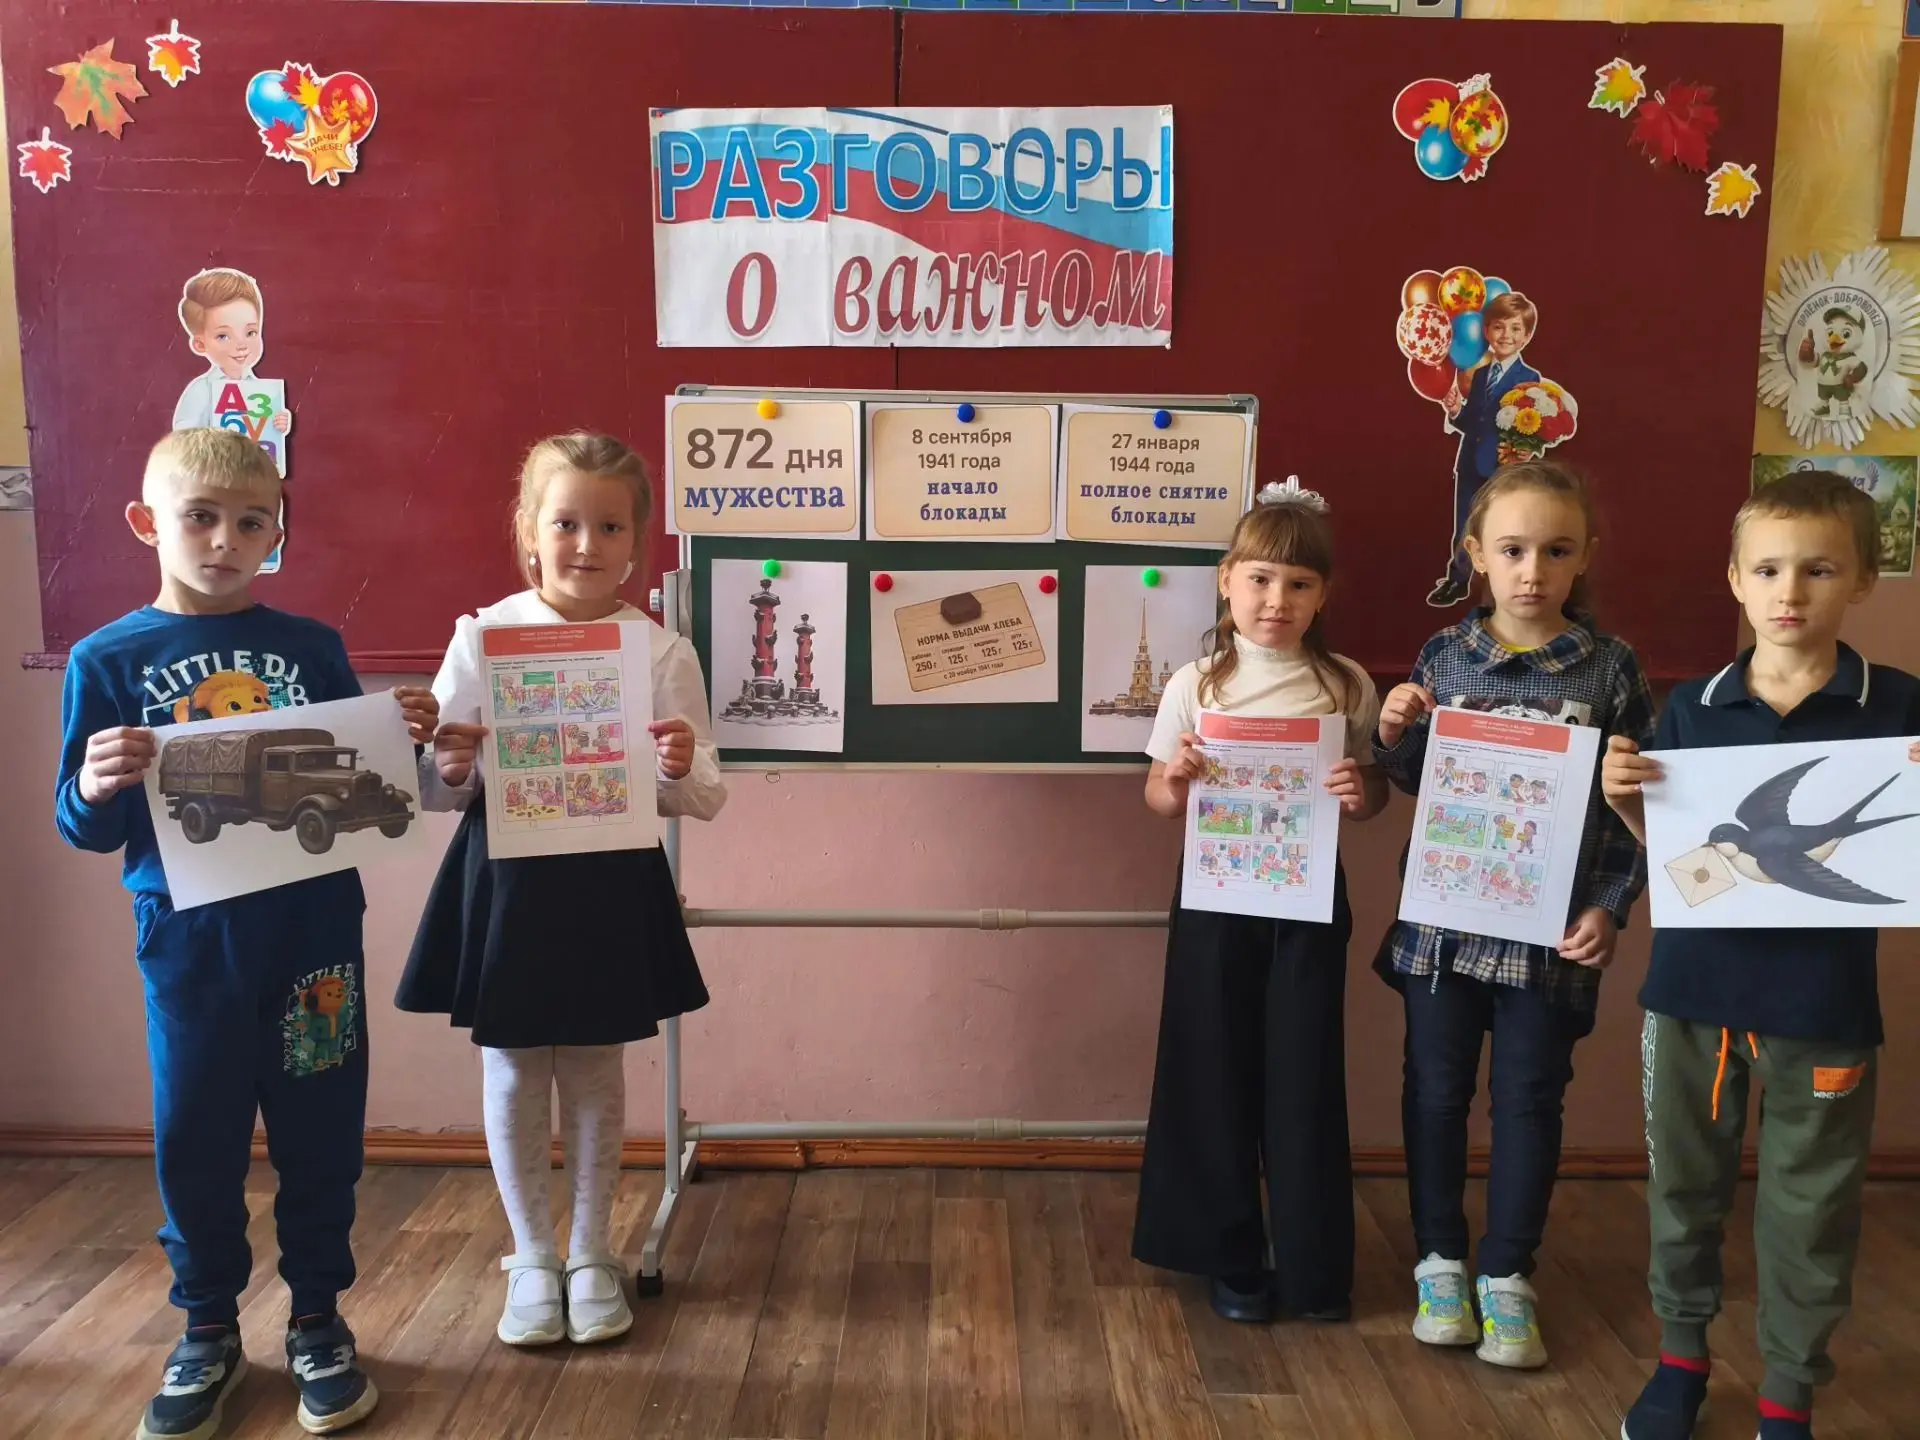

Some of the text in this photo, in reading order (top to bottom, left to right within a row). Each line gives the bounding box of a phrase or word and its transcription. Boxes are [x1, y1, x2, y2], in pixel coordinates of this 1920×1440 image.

[303, 133, 338, 148] УДАЧИ
[658, 125, 1172, 222] РАЗГОВОРЫ
[726, 249, 1166, 339] о важном
[912, 428, 1012, 447] 8 сентября
[1111, 433, 1200, 454] 27 января
[686, 427, 843, 474] 872 дня
[918, 453, 1001, 471] 1941 года
[1109, 456, 1196, 474] 1944 года
[927, 481, 999, 495] начало
[1080, 483, 1229, 500] полное снятие
[684, 485, 846, 516] мужества
[920, 503, 1007, 522] блокады
[1111, 506, 1196, 526] блокады
[916, 617, 1023, 647] НОРМА ВЫДАЧИ ХЛЕБА
[981, 646, 997, 658] 125
[1013, 639, 1029, 651] 125
[915, 660, 932, 672] 250
[948, 653, 964, 665] 125
[144, 650, 299, 703] LITTLE DJ
